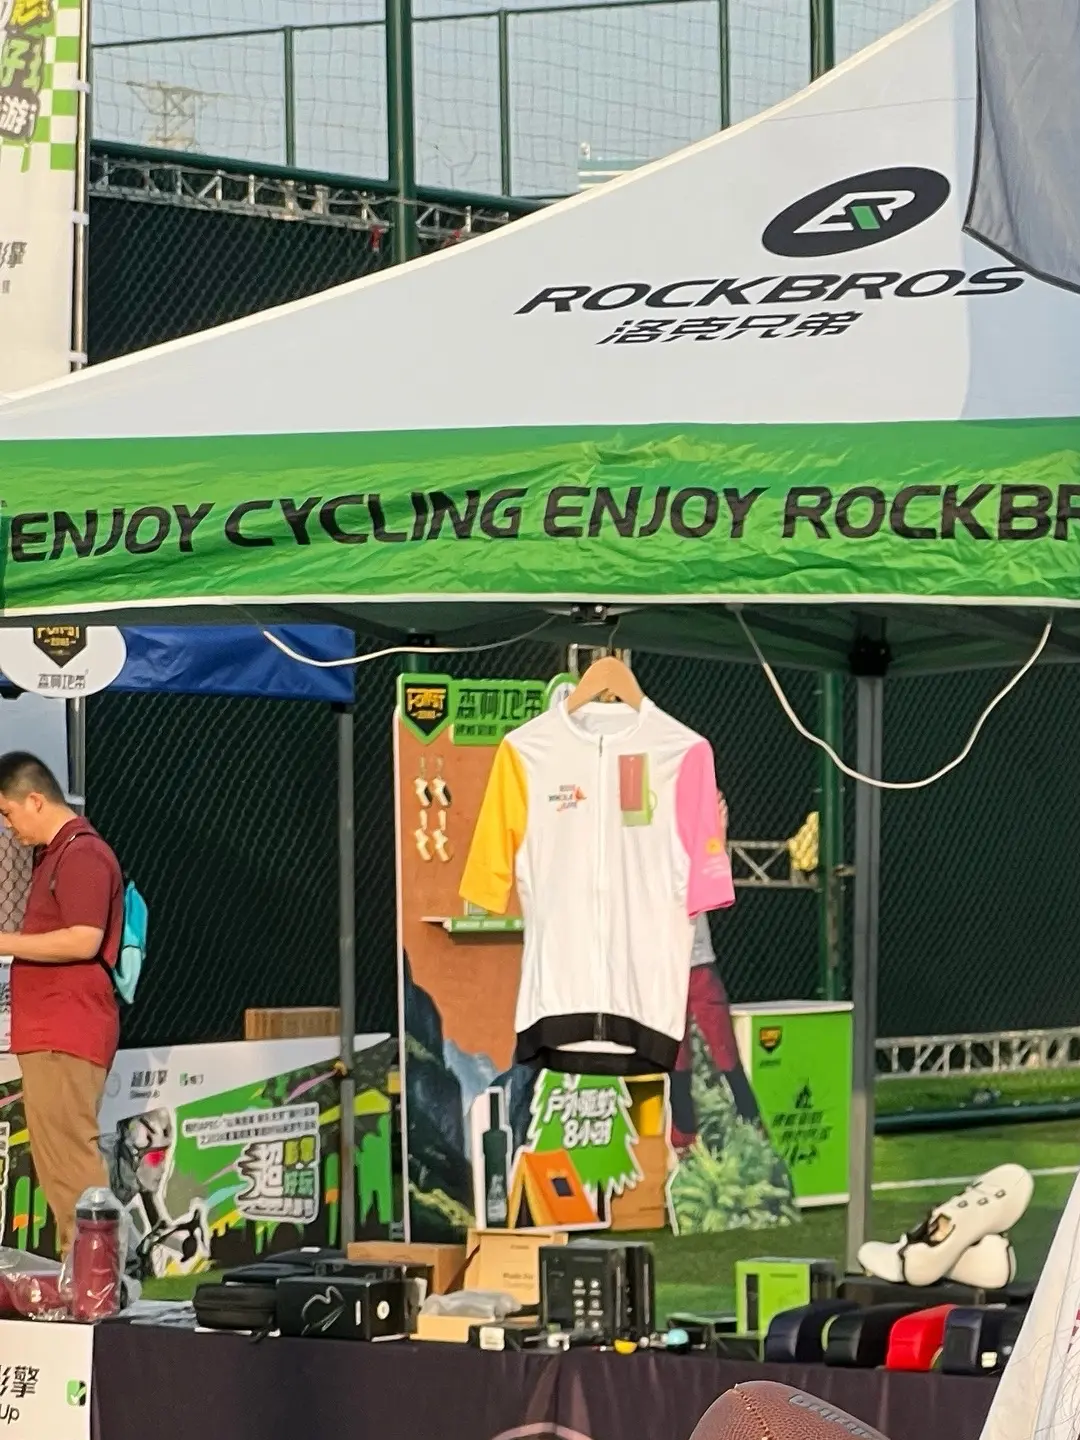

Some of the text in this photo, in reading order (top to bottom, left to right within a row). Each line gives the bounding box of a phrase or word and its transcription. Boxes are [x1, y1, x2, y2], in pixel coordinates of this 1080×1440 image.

[513, 265, 1027, 315] ROCKBROS
[596, 310, 864, 345] 洛克兄弟
[9, 502, 214, 563] ENJOY
[224, 486, 528, 547] CYCLING
[543, 485, 770, 540] ENJOY
